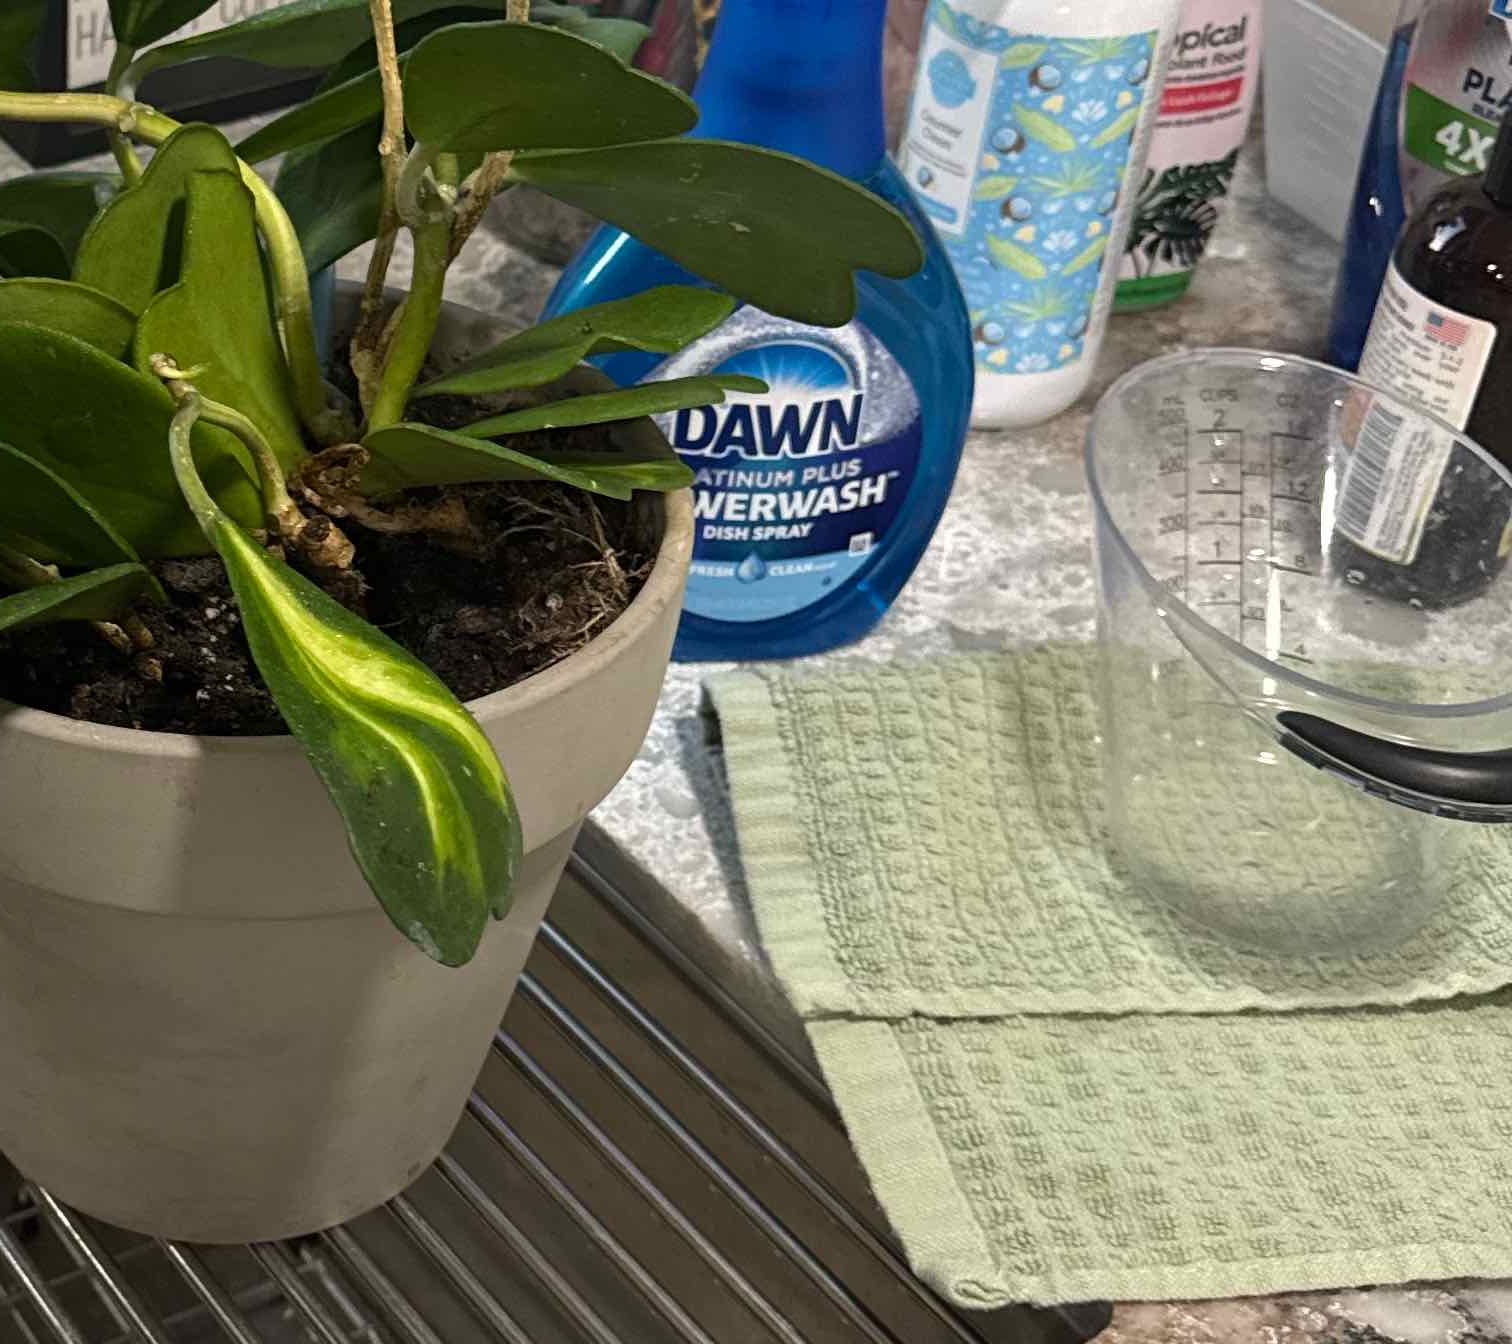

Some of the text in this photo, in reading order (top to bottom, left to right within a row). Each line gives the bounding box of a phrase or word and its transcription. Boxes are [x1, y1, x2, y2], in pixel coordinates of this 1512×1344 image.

[1436, 120, 1496, 172] 4X
[672, 391, 865, 457] DAWN
[693, 458, 863, 491] ATINUM PLUS
[702, 522, 815, 541] DISH SPRAY
